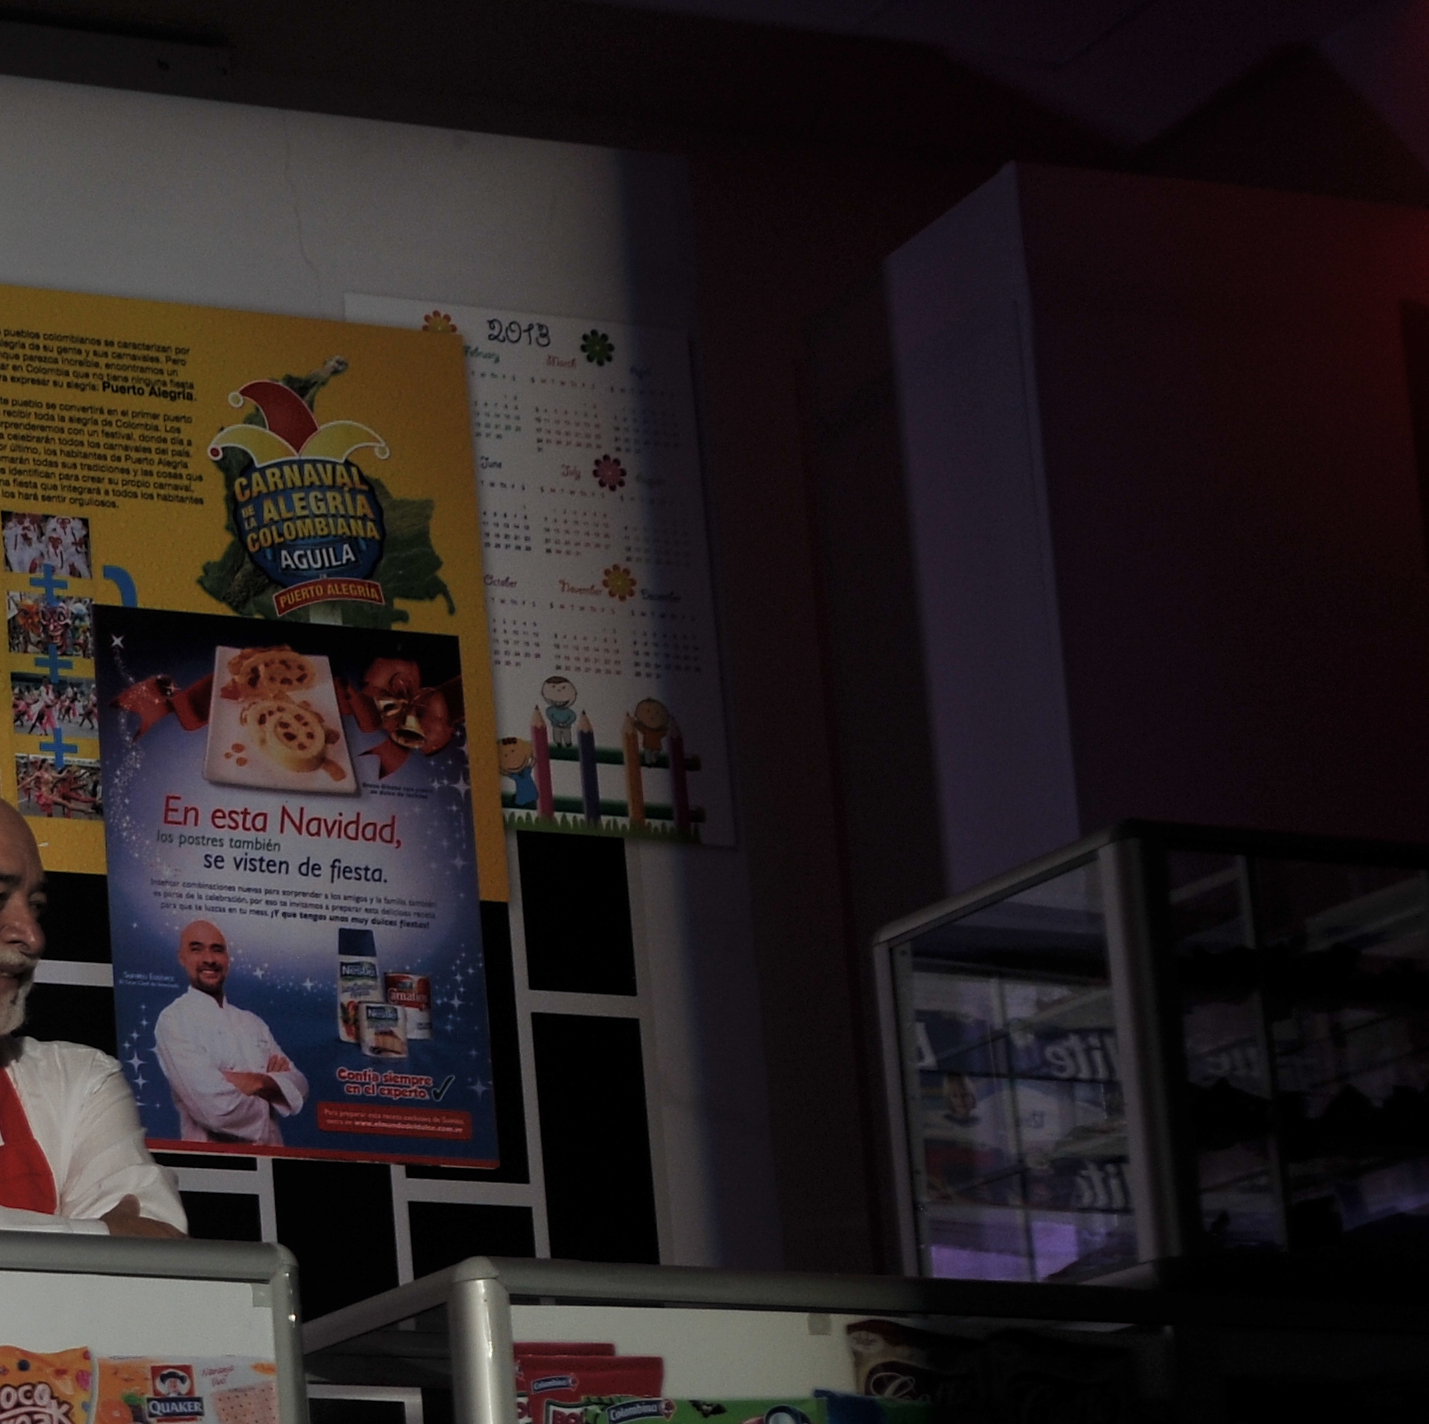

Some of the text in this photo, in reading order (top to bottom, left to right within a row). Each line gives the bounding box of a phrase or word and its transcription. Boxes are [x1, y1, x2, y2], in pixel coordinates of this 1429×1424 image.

[487, 319, 550, 347] 2013
[103, 382, 197, 401] Puerto Alegría.
[234, 462, 370, 501] CARNAVAL
[242, 505, 256, 518] DE
[263, 487, 375, 524] ALEGRÍA
[244, 517, 257, 529] LA
[246, 516, 381, 553] COLOMBIANA
[280, 544, 356, 570] AGUILA
[279, 582, 379, 607] PUERTO ALEGRÍA
[163, 796, 401, 849] En esta Navidad,
[157, 829, 281, 854] los postres también
[203, 852, 388, 884] se visten de fiesta.
[338, 1068, 432, 1085] Confía siempre
[345, 1084, 361, 1094] en
[364, 1084, 375, 1094] el
[148, 1400, 203, 1415] QUAKER
